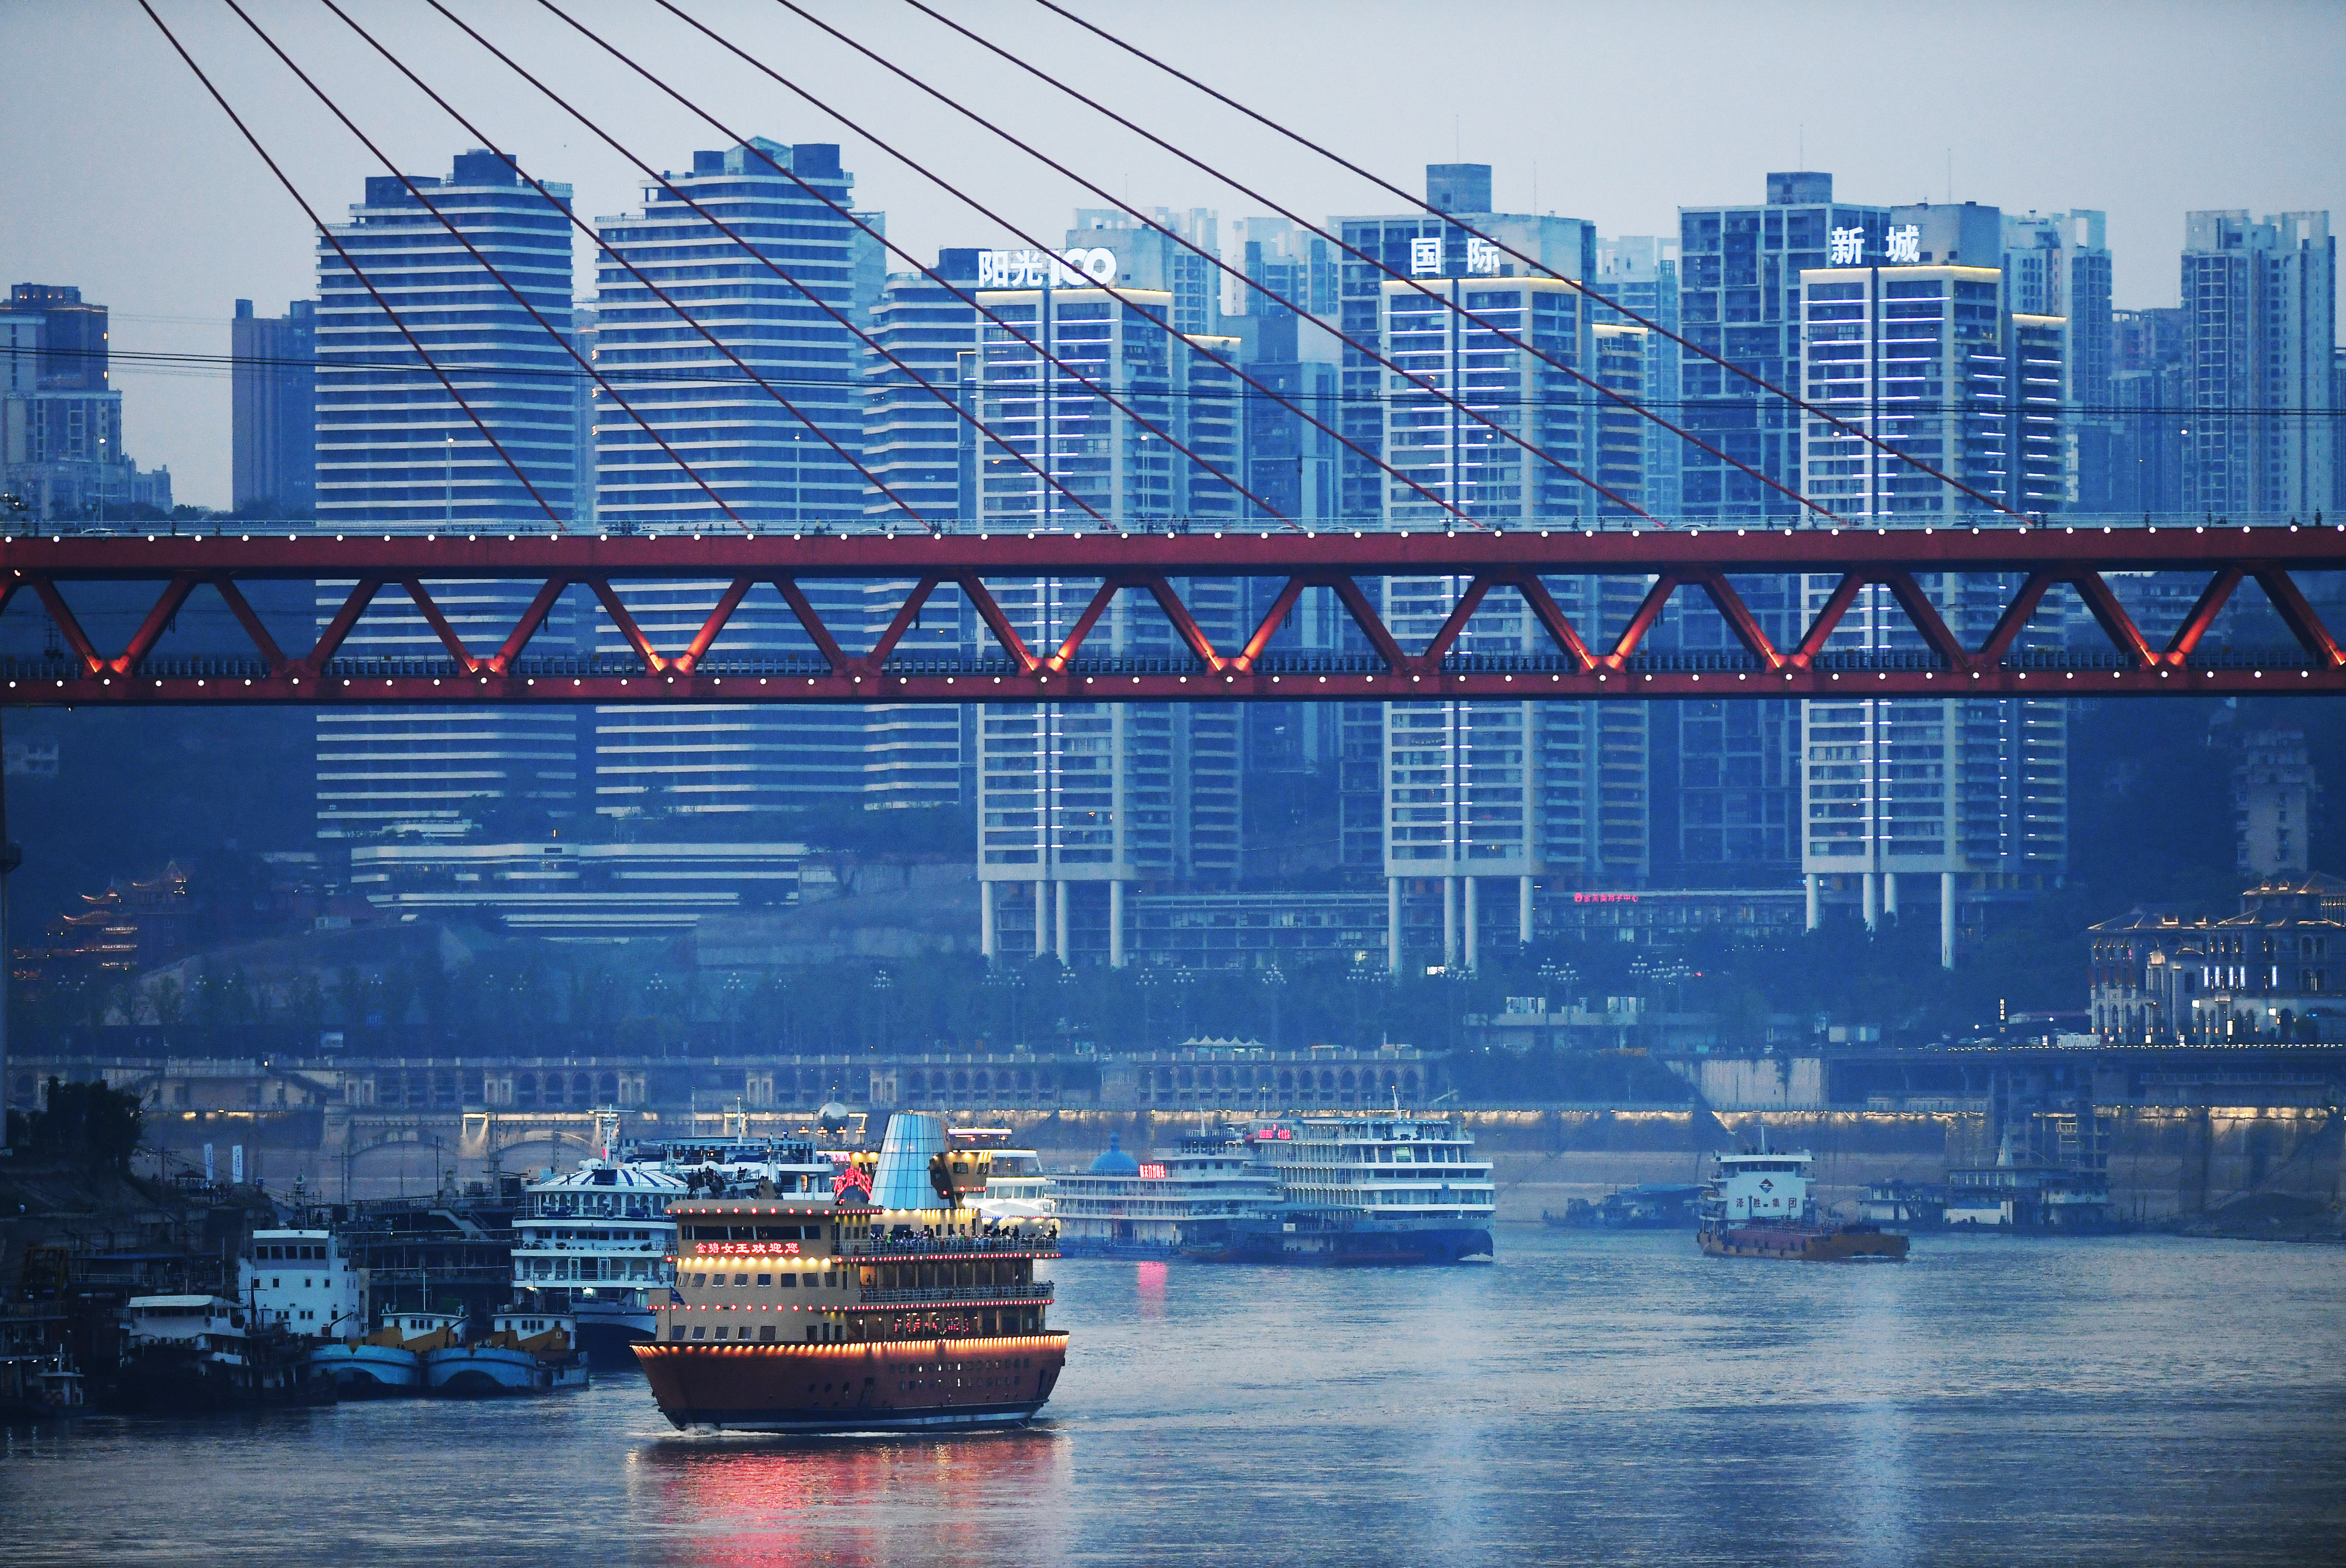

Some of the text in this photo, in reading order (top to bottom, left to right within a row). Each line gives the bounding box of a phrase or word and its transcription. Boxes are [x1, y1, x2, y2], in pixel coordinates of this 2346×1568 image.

[1411, 237, 1501, 274] 国际
[1831, 225, 1920, 264] 新城
[978, 247, 1117, 287] 阳光100
[1736, 1197, 1797, 1208] 泽胜集团
[695, 1241, 800, 1254] 金碧女王欢迎您
